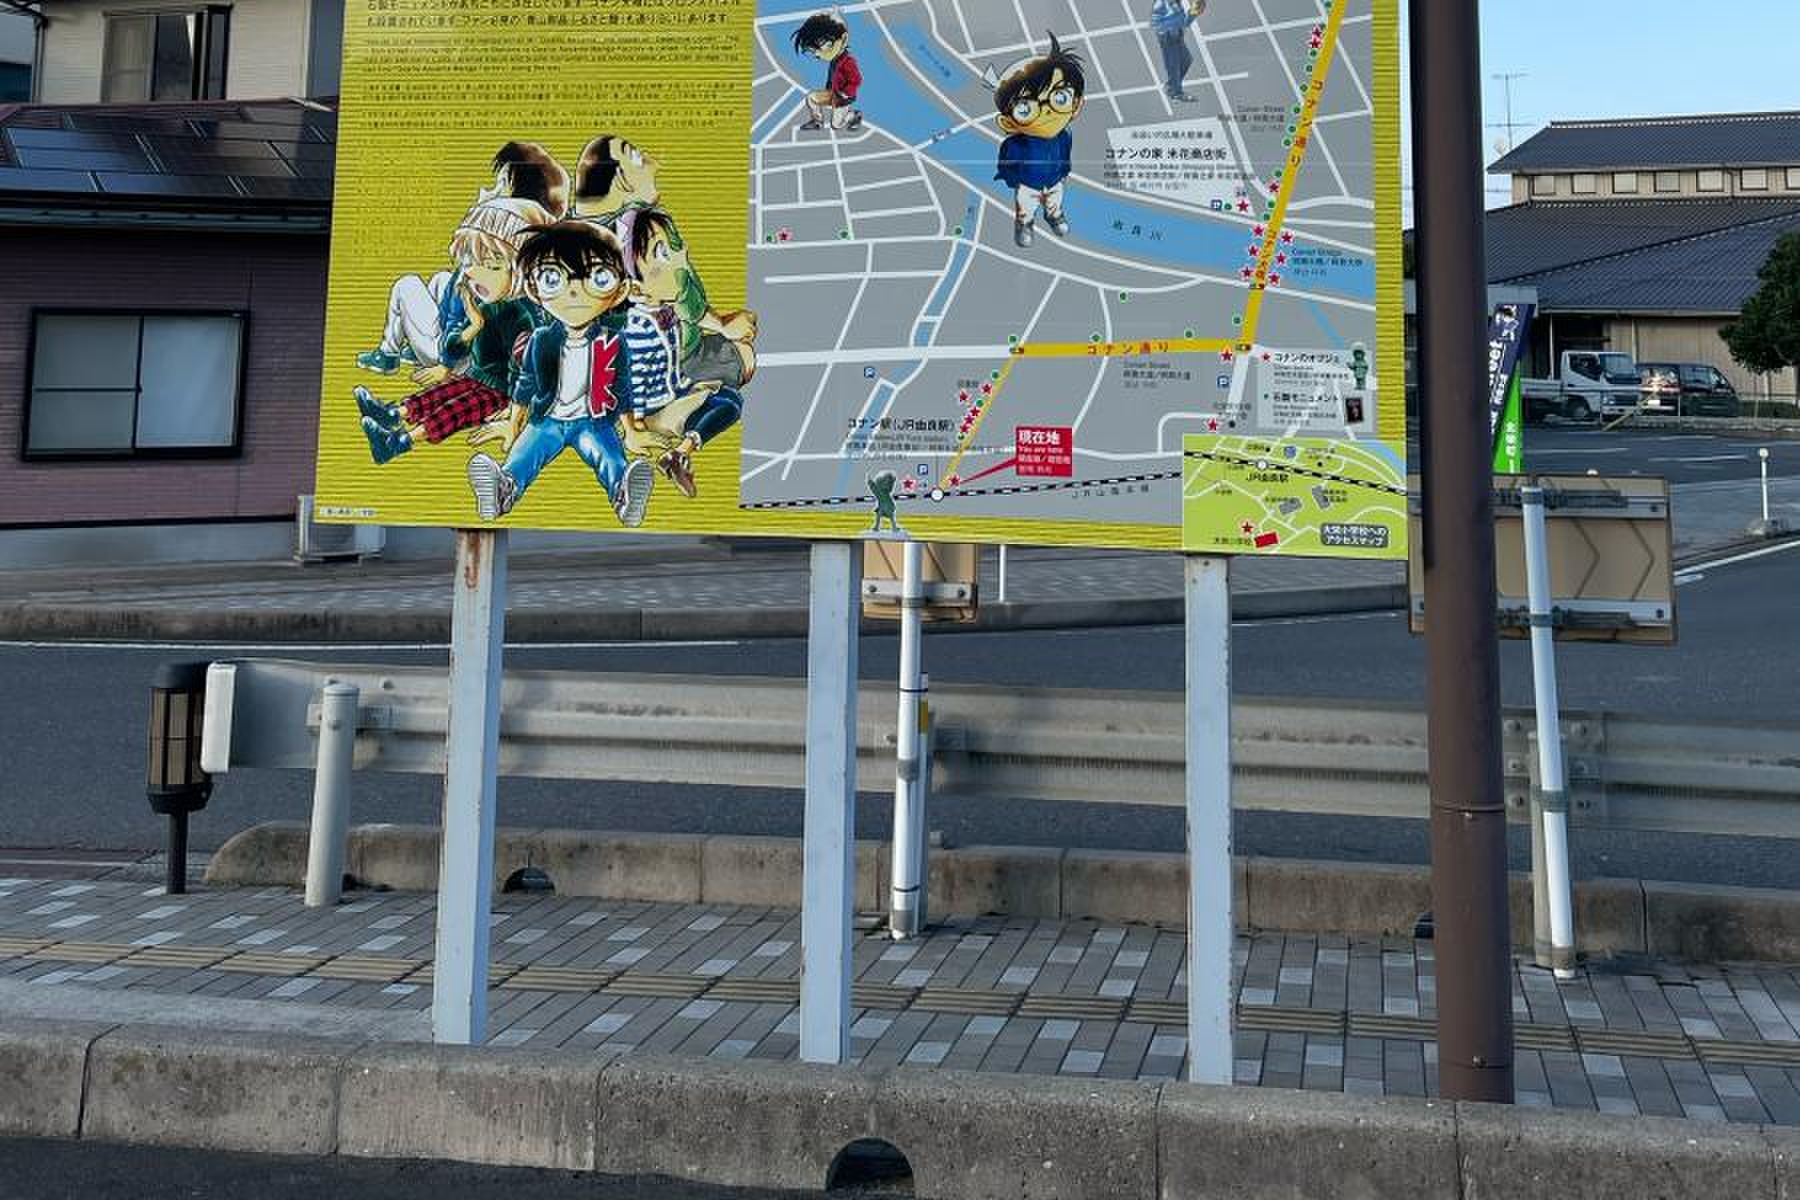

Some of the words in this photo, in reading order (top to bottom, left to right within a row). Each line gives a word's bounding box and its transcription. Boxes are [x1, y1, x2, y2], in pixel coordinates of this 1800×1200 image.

[1105, 147, 1163, 160] コナンの家
[1087, 341, 1169, 355] コナン通り
[1018, 429, 1061, 445] 現在地
